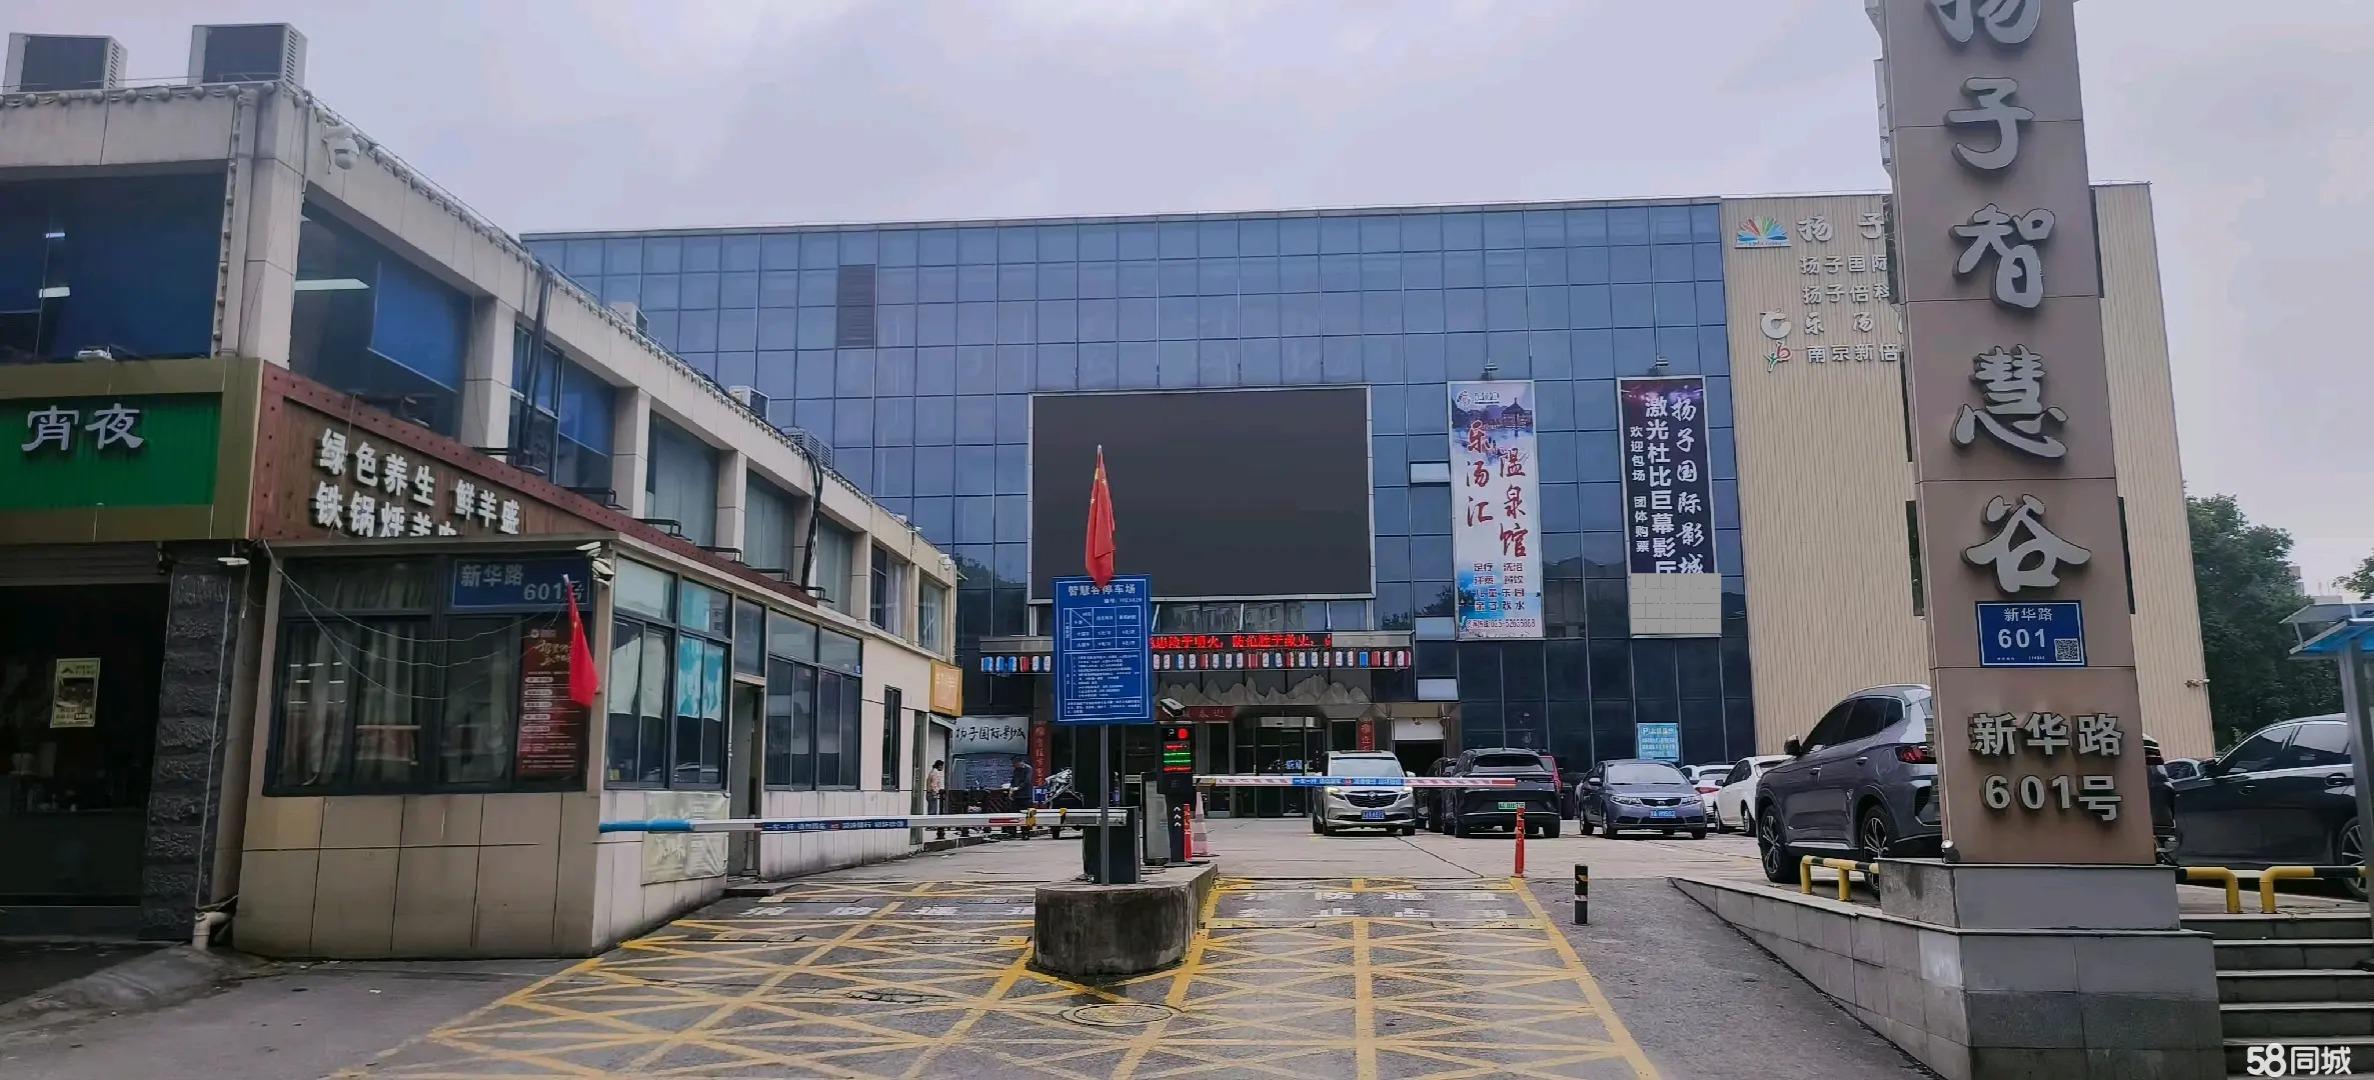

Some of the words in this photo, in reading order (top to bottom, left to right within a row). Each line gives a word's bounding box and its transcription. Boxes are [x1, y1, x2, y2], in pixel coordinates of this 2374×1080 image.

[1800, 254, 1887, 275] 扬子国际
[1804, 310, 1903, 335] 乐汤
[1806, 343, 1901, 363] 南京新倍
[21, 403, 144, 451] 宵夜
[319, 428, 435, 507] 绿色养生
[1630, 426, 1646, 482] 欢迎包场
[1671, 398, 1704, 573] 扬子国际影城
[1634, 496, 1650, 553] 团体购票
[460, 563, 523, 587] 新华路
[524, 580, 584, 600] 601号
[2004, 607, 2052, 621] 新华路
[1998, 628, 2045, 648] 601
[1971, 713, 2122, 757] 新华路
[1984, 775, 2121, 821] 601号
